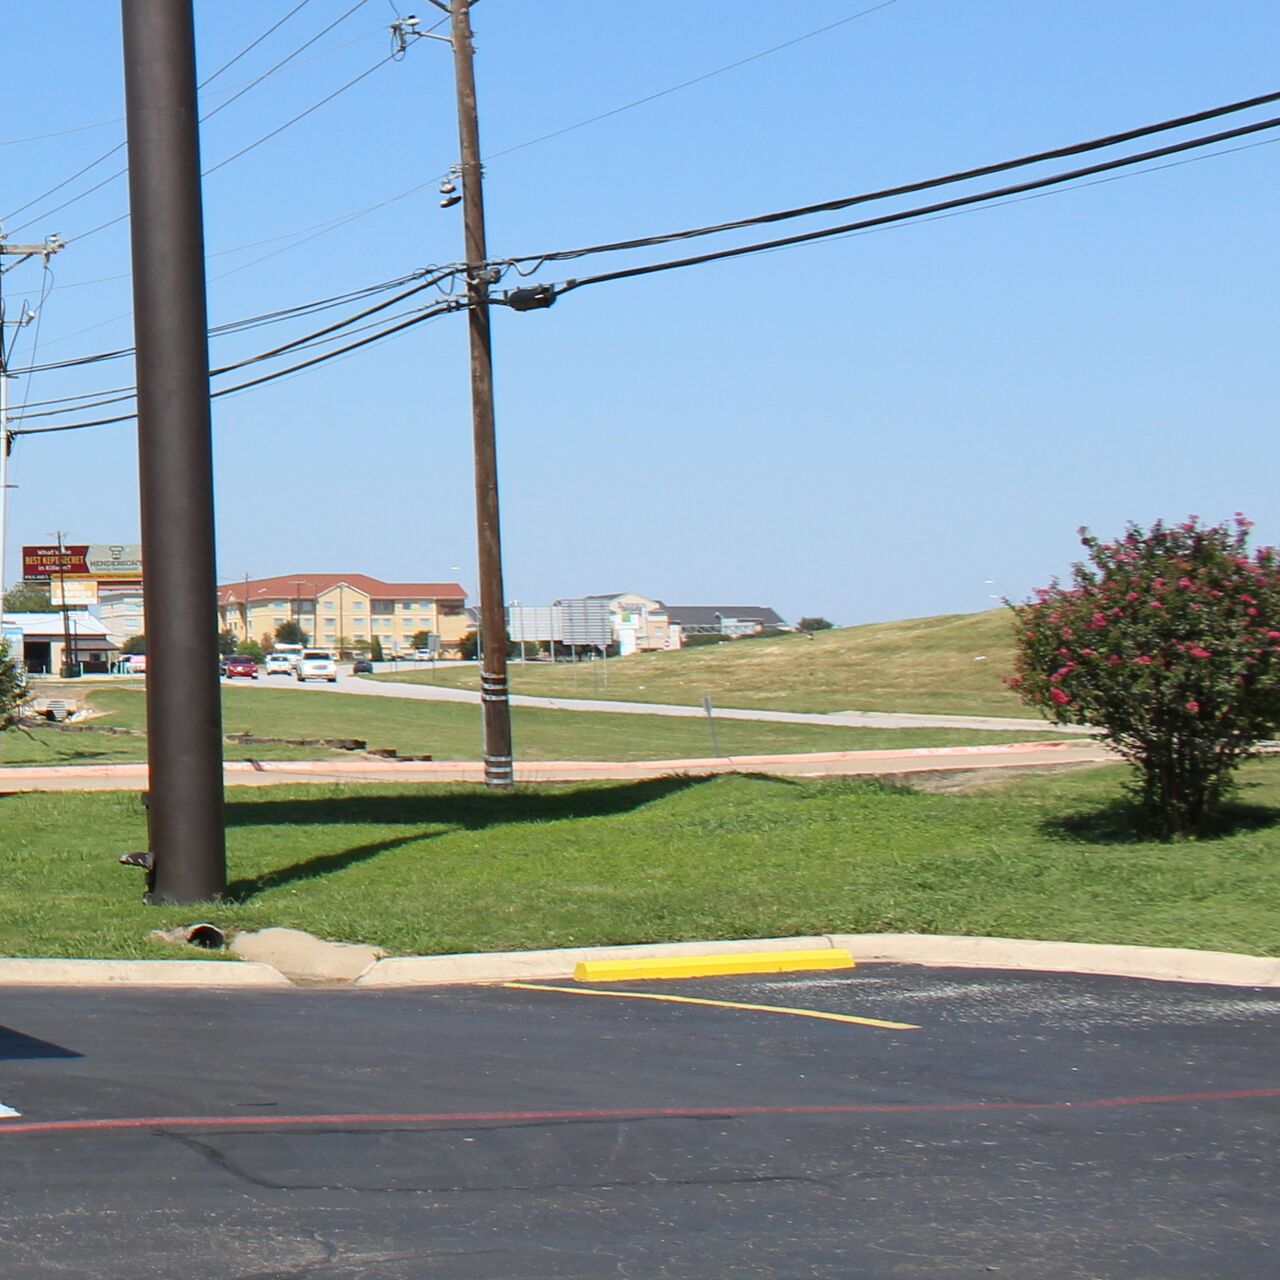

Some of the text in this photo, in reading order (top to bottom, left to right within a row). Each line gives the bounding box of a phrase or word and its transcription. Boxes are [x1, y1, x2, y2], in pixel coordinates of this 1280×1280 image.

[25, 556, 41, 564] BEST
[42, 556, 59, 564] KEPT
[55, 589, 92, 598] Sorage
